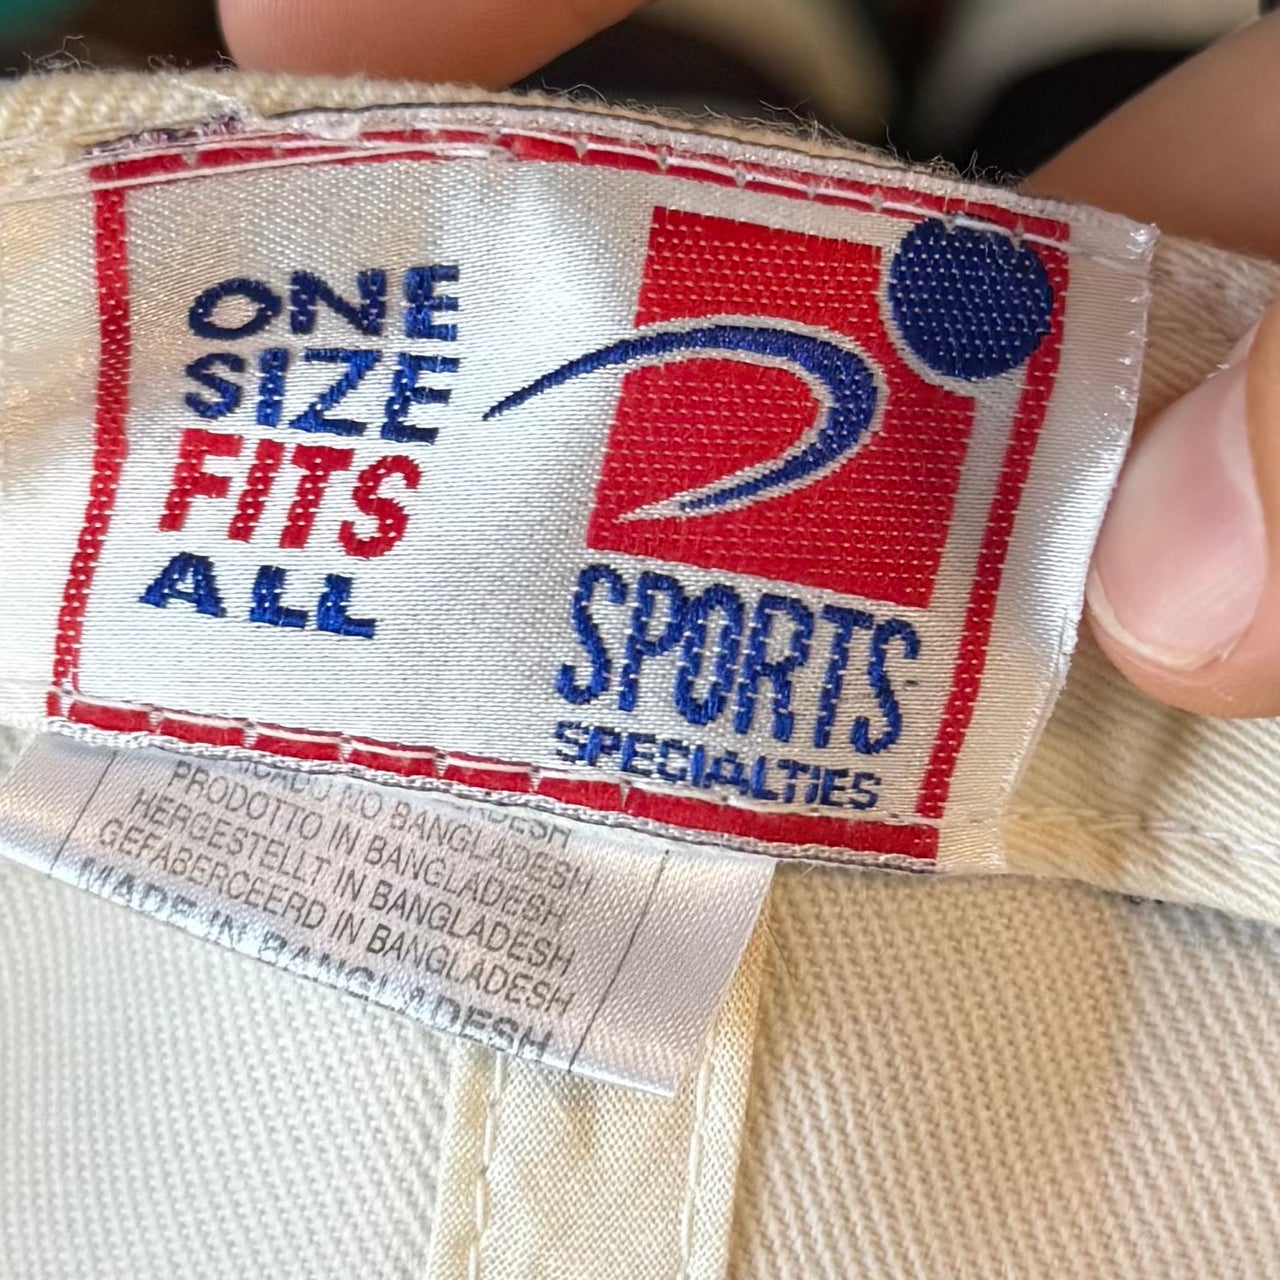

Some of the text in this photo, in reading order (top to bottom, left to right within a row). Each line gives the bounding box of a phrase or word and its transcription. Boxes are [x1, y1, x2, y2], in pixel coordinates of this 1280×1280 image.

[188, 265, 460, 342] ONE
[185, 347, 460, 445] SIZE
[158, 428, 422, 560] FITS
[139, 551, 377, 638] ALL
[556, 564, 921, 754] SPORTS
[555, 720, 882, 809] SPECIALTIES
[129, 788, 576, 977] HERGESTELLT IN BANGLADESH
[168, 760, 568, 927] PRODOTTO IN BANGLADESH
[389, 801, 593, 898] BANGLADESH
[330, 909, 366, 945] IN
[366, 923, 576, 1015] BANGLADESH
